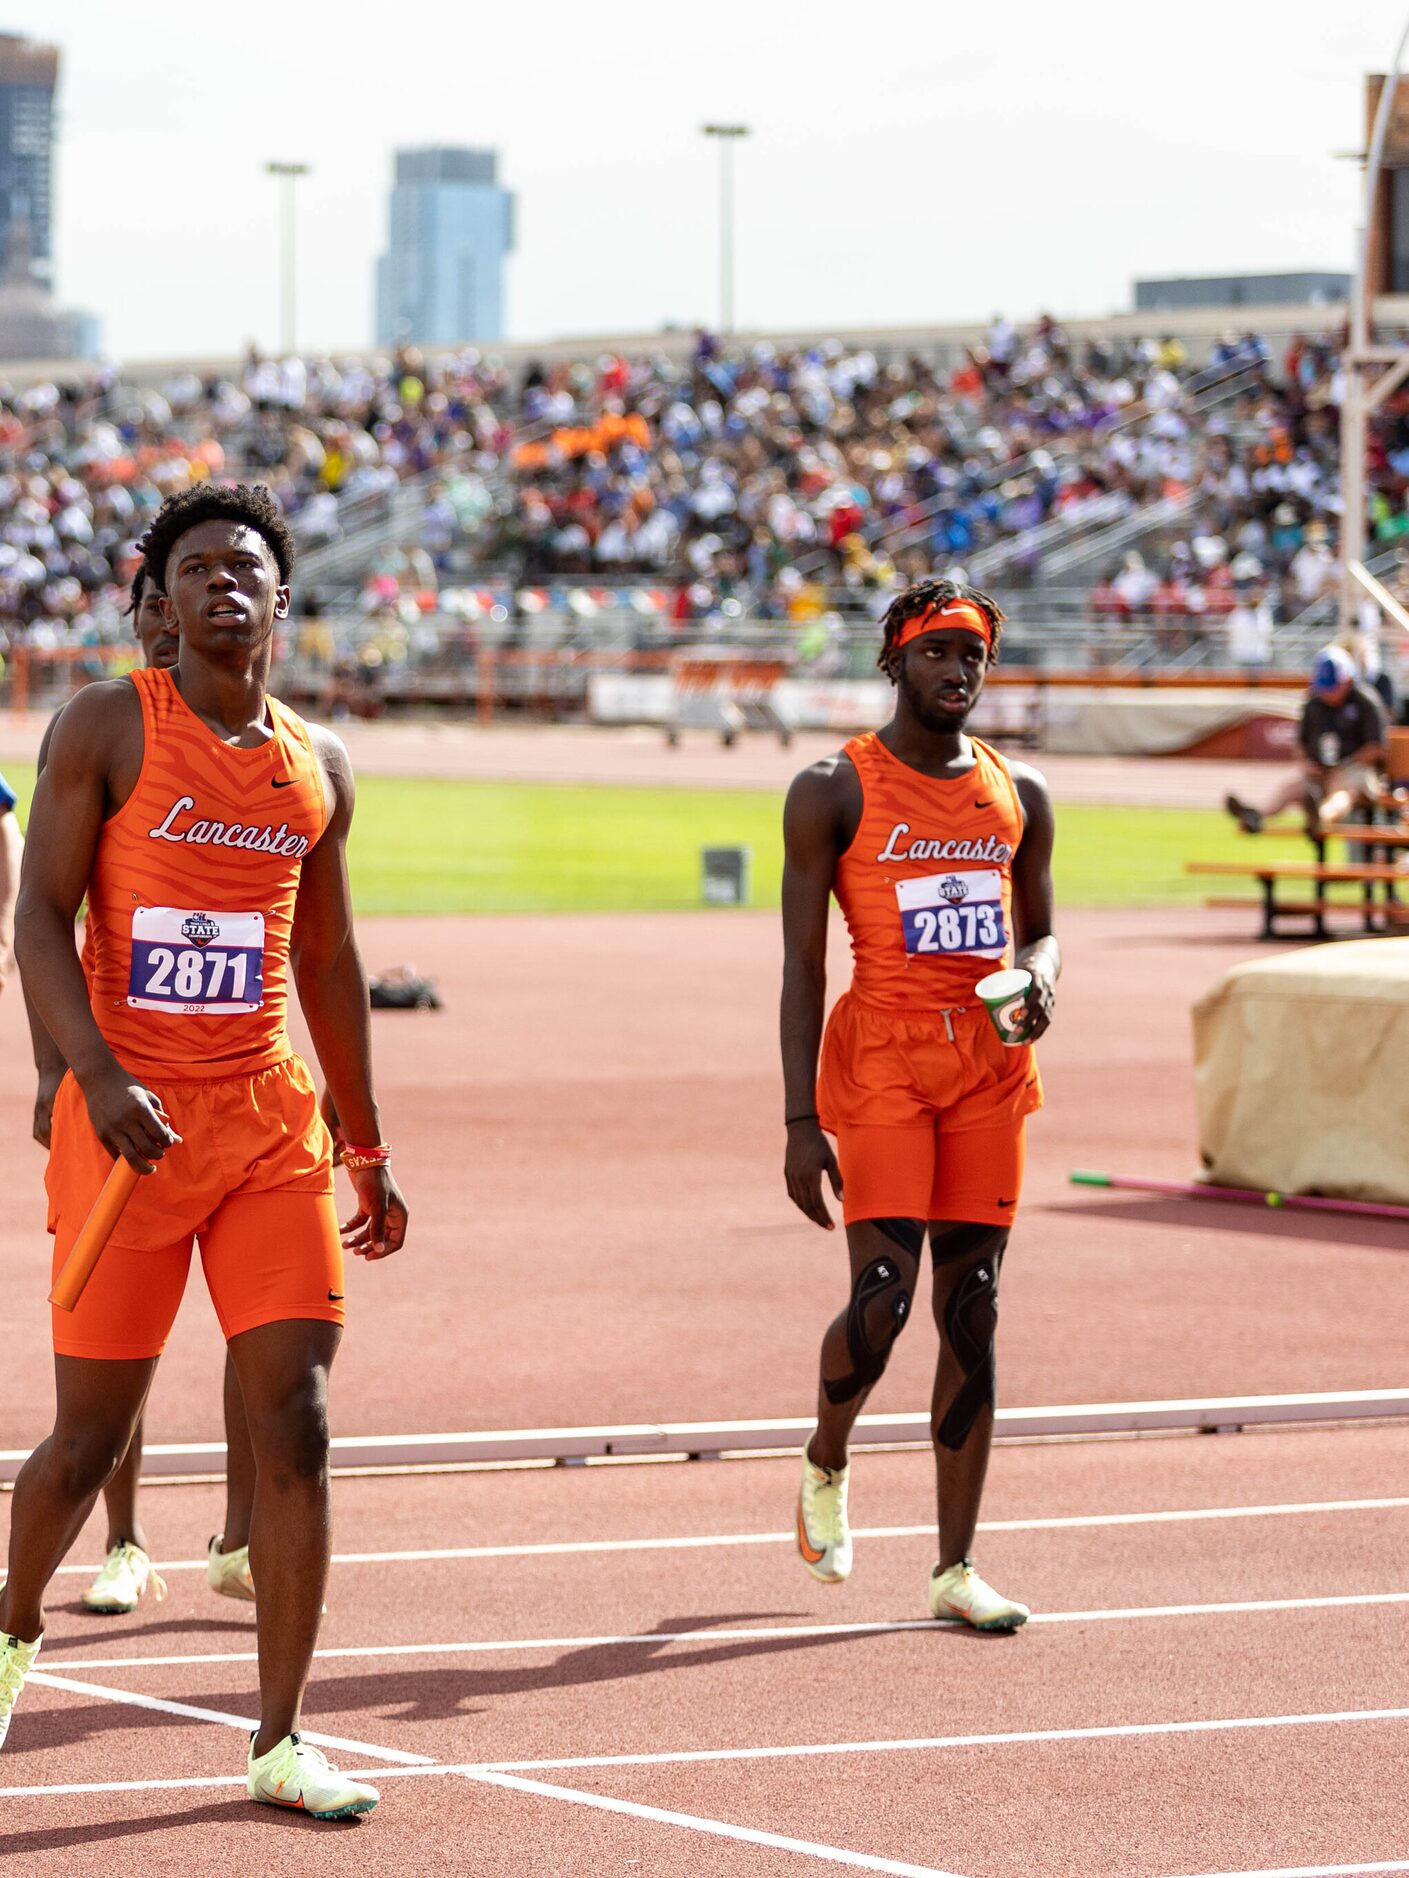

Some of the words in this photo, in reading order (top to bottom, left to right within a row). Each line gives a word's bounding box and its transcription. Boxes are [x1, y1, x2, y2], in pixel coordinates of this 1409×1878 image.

[148, 796, 309, 858] Lancaster
[877, 822, 1013, 864] Lancaster
[182, 925, 219, 935] STATE
[914, 904, 998, 952] 2873
[145, 947, 248, 999] 2871
[183, 1004, 205, 1012] 2022
